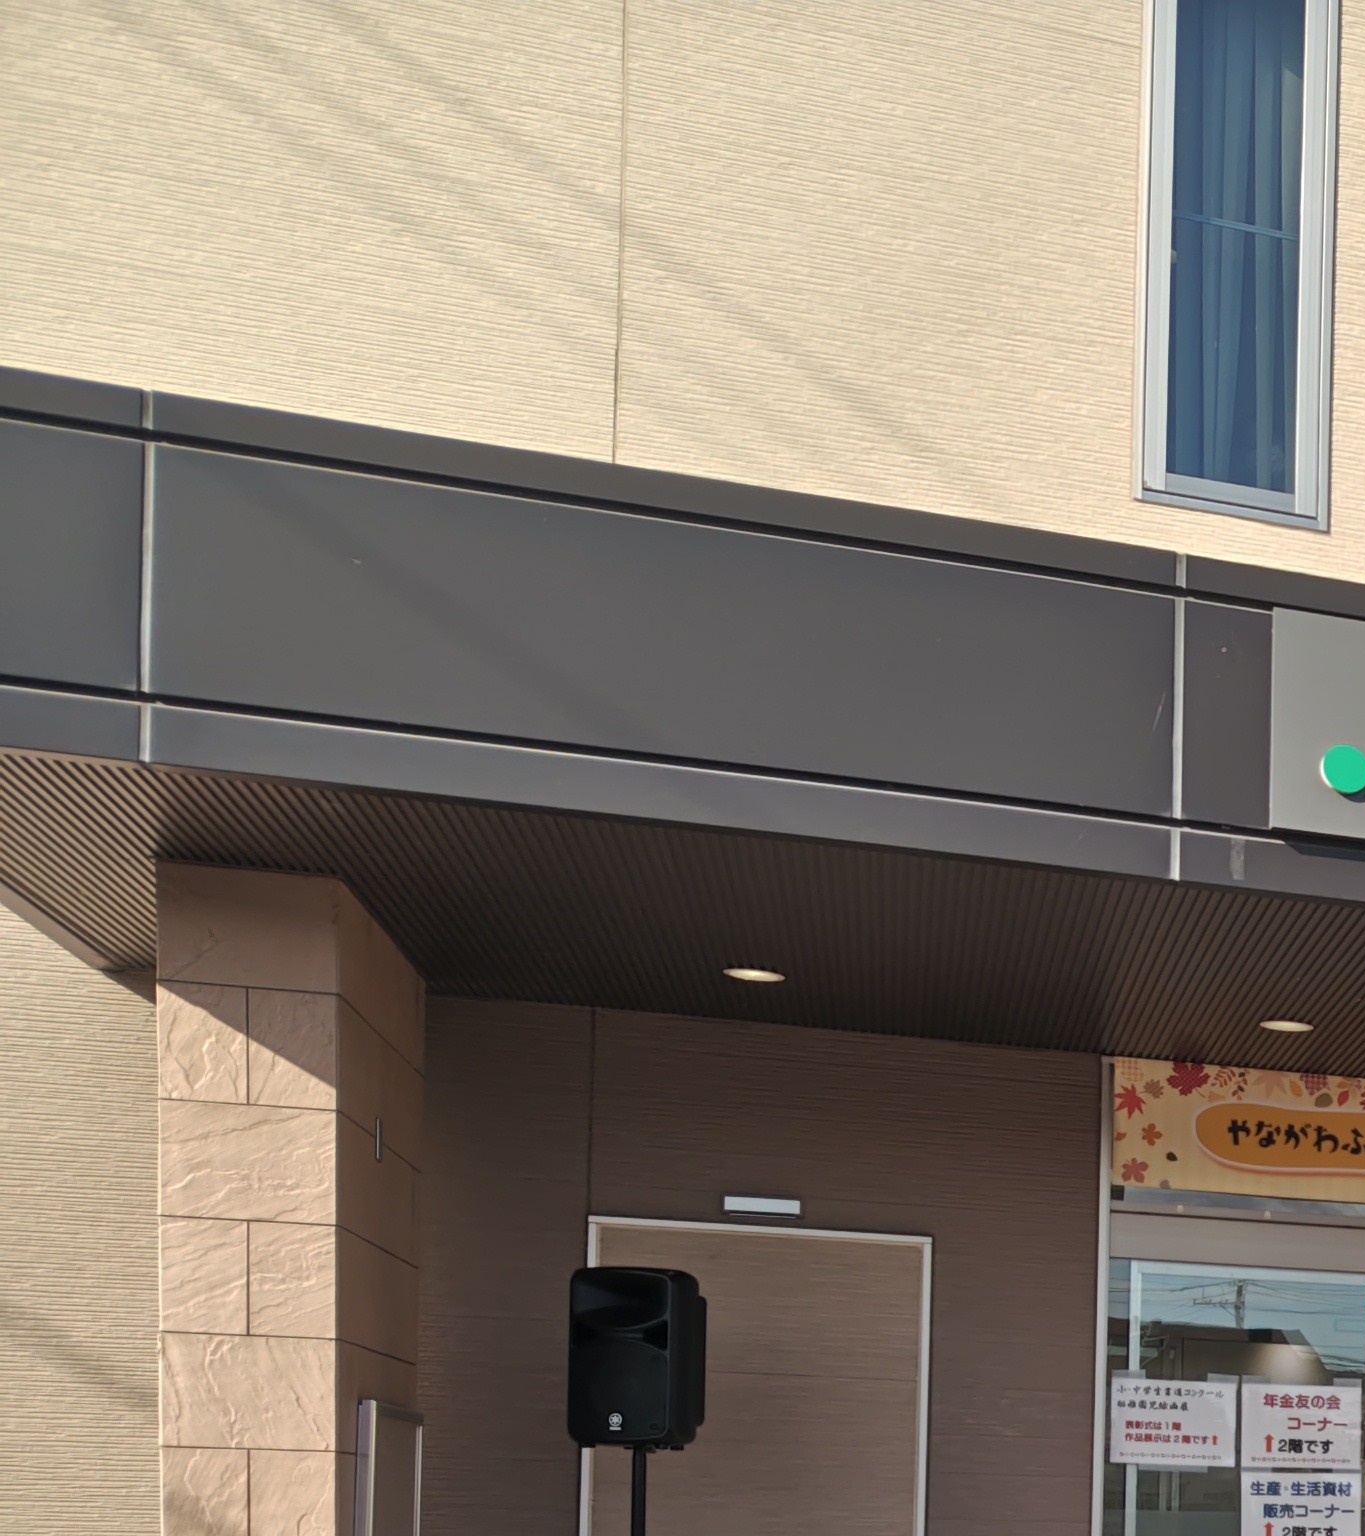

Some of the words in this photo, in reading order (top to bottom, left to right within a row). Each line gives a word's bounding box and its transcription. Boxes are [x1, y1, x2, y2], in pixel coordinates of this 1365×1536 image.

[1263, 1393, 1342, 1410] 年金友の会
[1286, 1416, 1349, 1431] コーナー
[1277, 1438, 1335, 1454] 2階です
[1262, 1502, 1356, 1520] 販売コーナー
